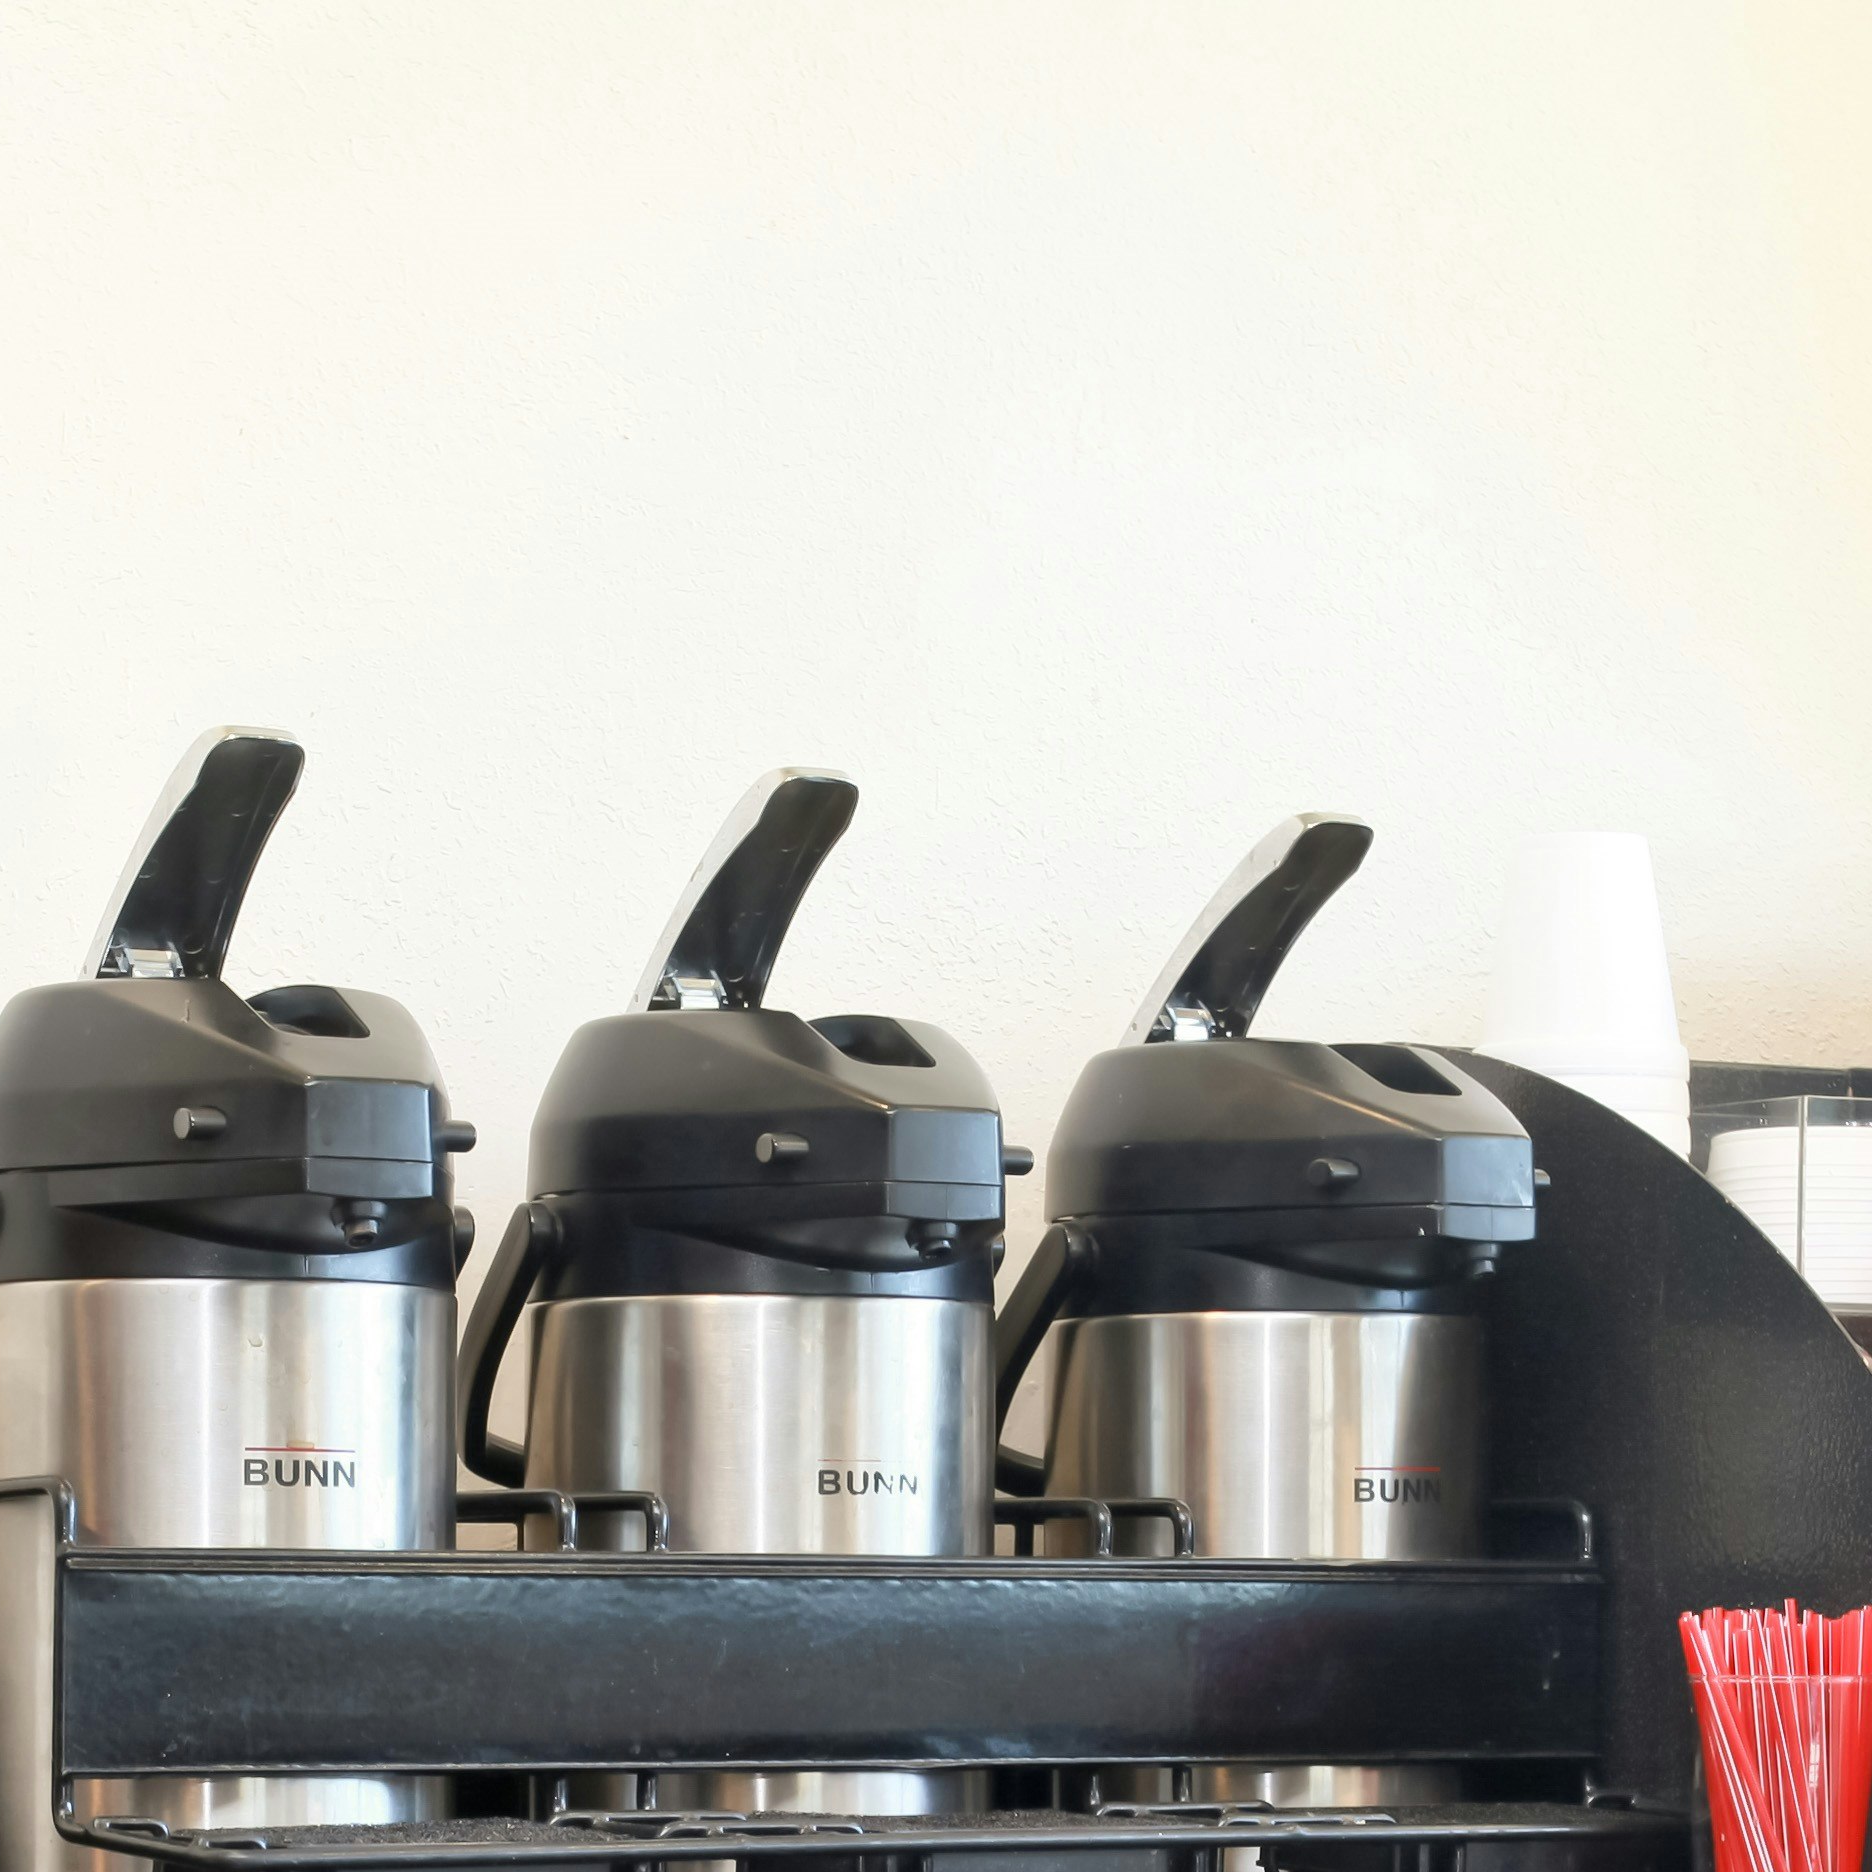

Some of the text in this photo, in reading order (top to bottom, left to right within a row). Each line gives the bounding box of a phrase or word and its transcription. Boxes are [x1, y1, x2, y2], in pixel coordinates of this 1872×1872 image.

[243, 1458, 356, 1488] BUNN
[817, 1468, 918, 1496] BUNN
[1353, 1477, 1441, 1504] BUNN
